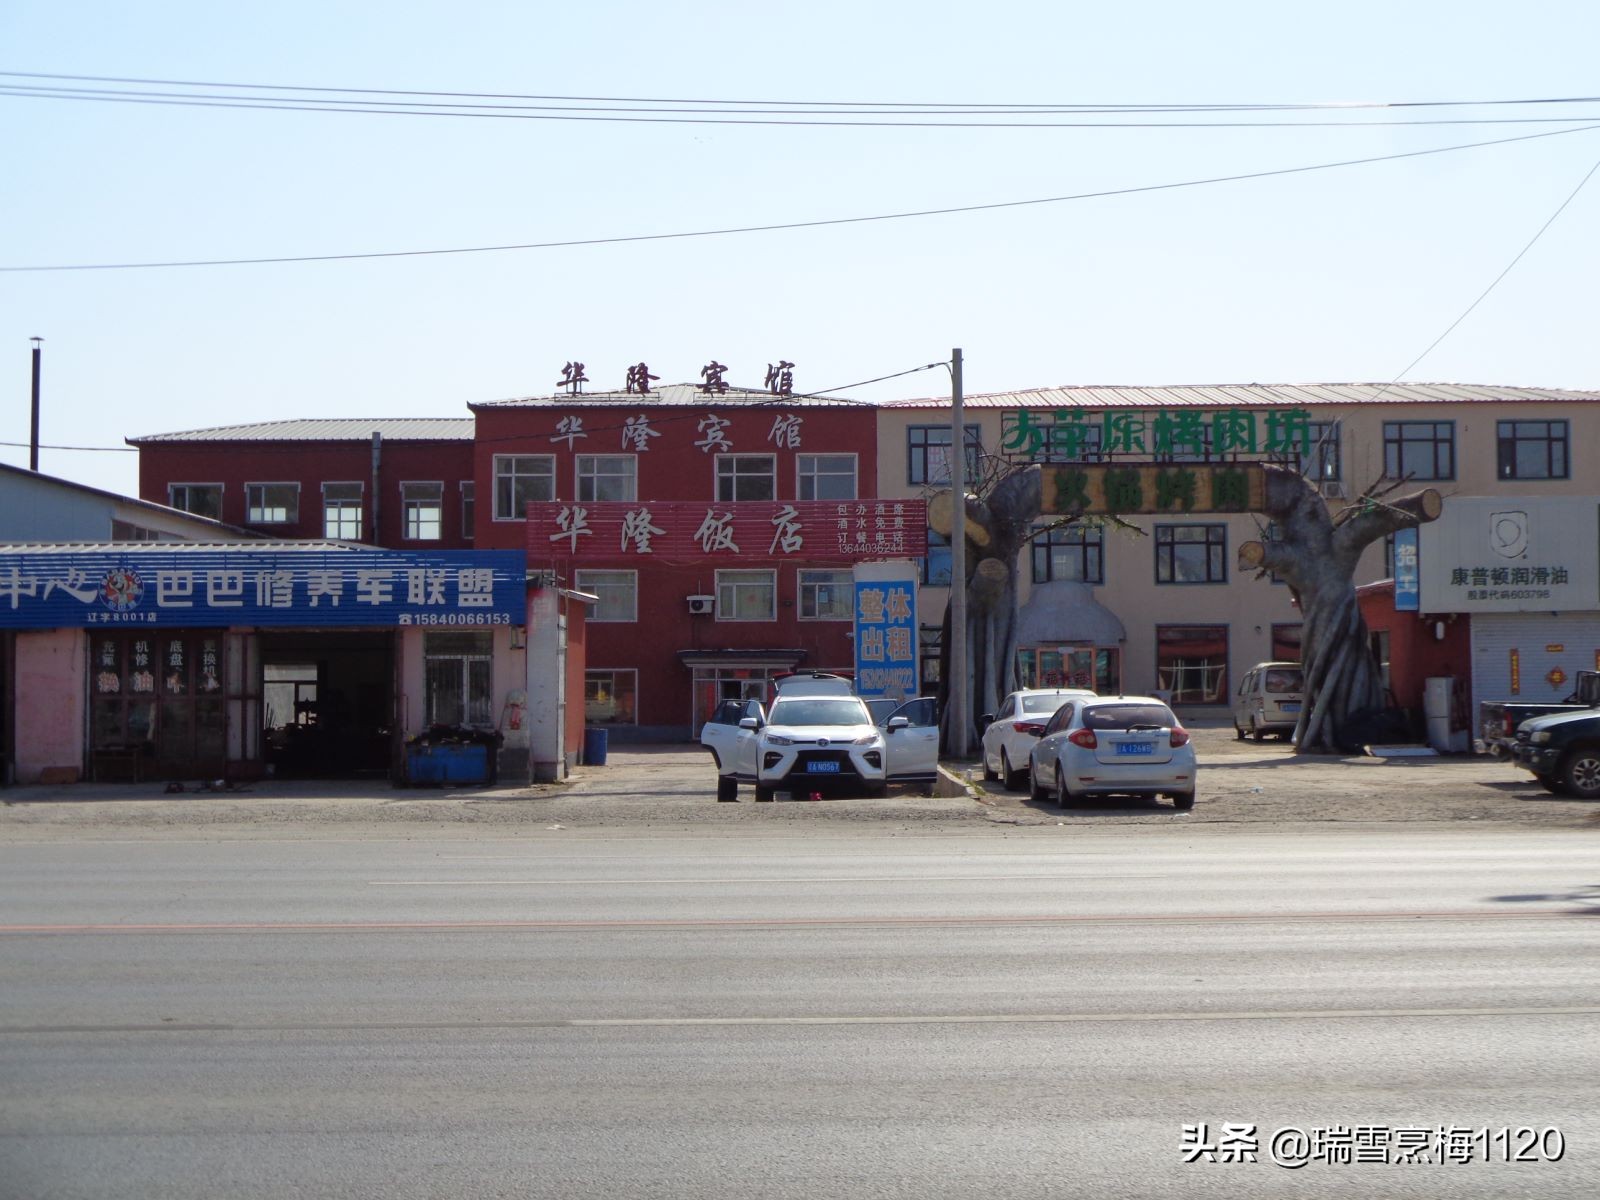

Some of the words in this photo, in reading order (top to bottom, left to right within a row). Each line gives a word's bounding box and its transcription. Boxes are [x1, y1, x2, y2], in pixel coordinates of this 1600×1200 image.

[556, 361, 796, 396] 华隆宾馆
[550, 414, 803, 453] 华隆宾馆
[549, 504, 804, 555] 华隆饭店
[156, 569, 495, 608] 巴巴修养车联盟
[1450, 566, 1568, 586] 康普顿润滑油
[414, 613, 511, 625] 15840066153
[859, 588, 912, 624] 整体
[861, 626, 913, 662] 出租
